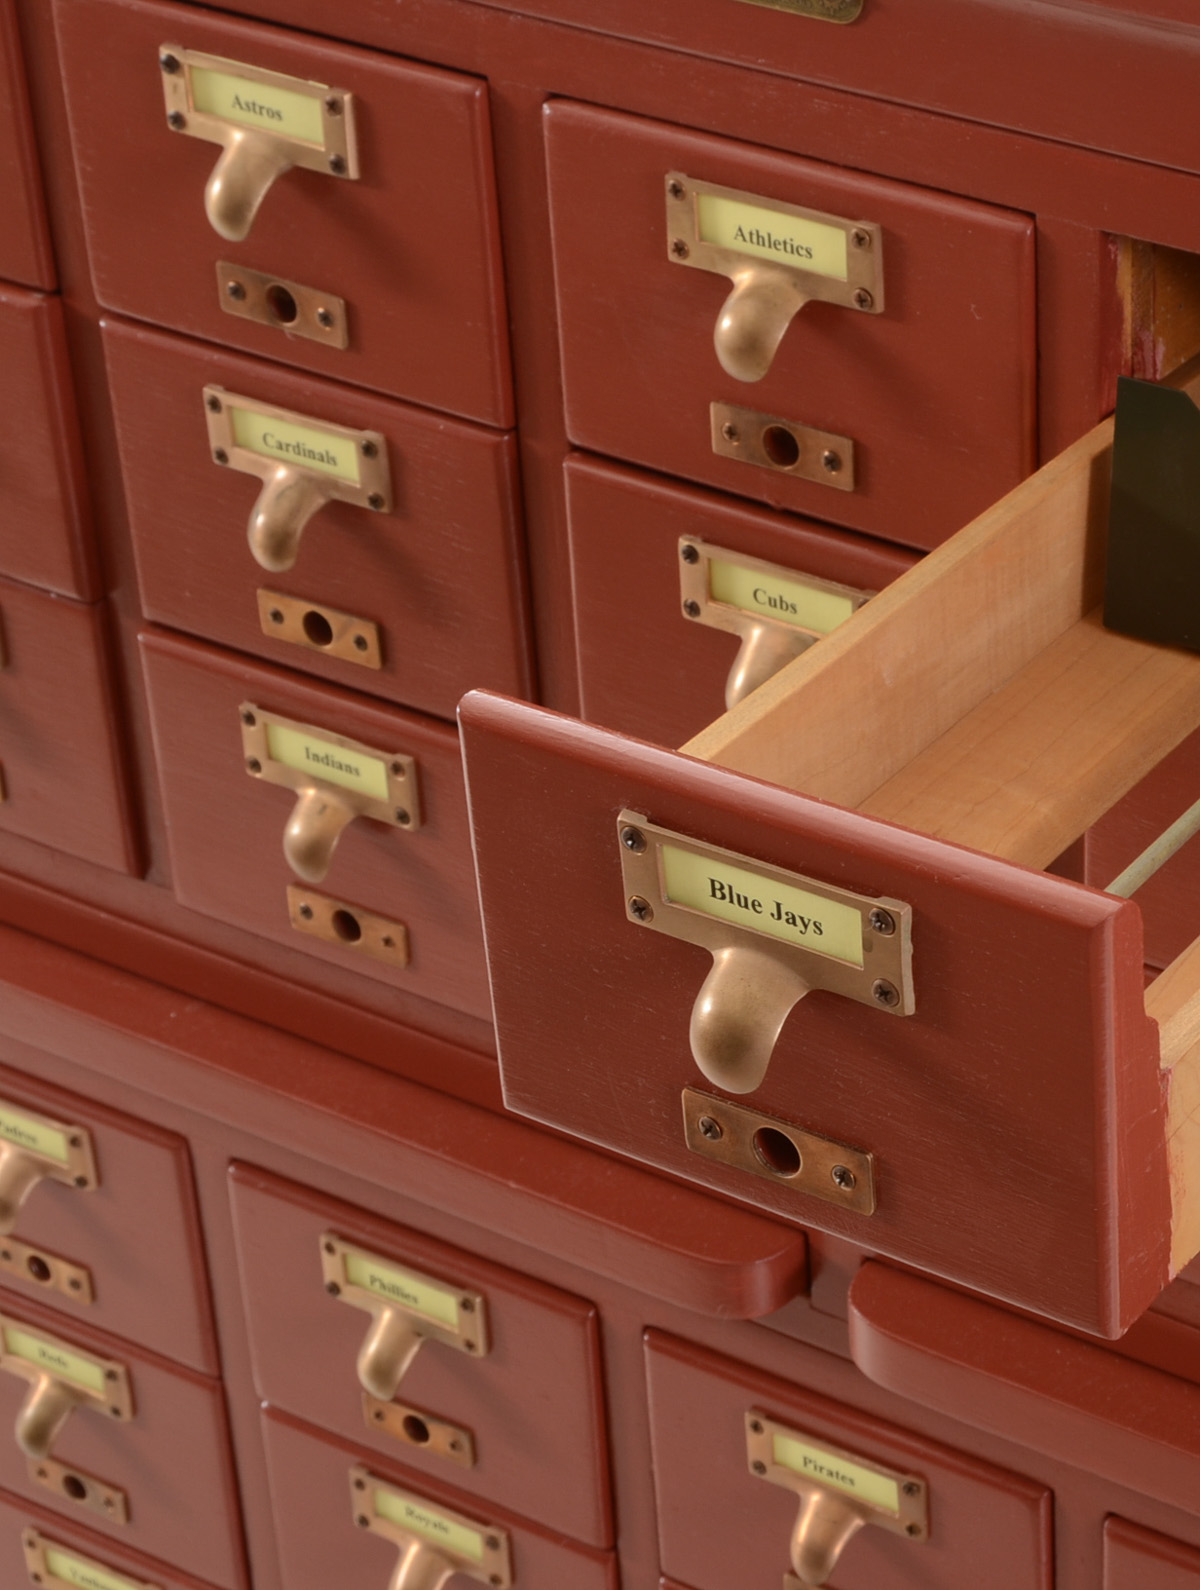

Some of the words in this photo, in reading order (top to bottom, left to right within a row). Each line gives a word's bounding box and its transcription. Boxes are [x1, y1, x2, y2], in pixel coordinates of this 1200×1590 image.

[232, 93, 283, 121] Astros
[734, 225, 814, 260] Athletics
[262, 432, 338, 466] Cardinals
[752, 587, 798, 615] Cubs
[304, 746, 361, 776] Indians
[707, 877, 763, 914] Blue
[770, 900, 824, 937] Jays
[802, 1455, 856, 1487] Pirates
